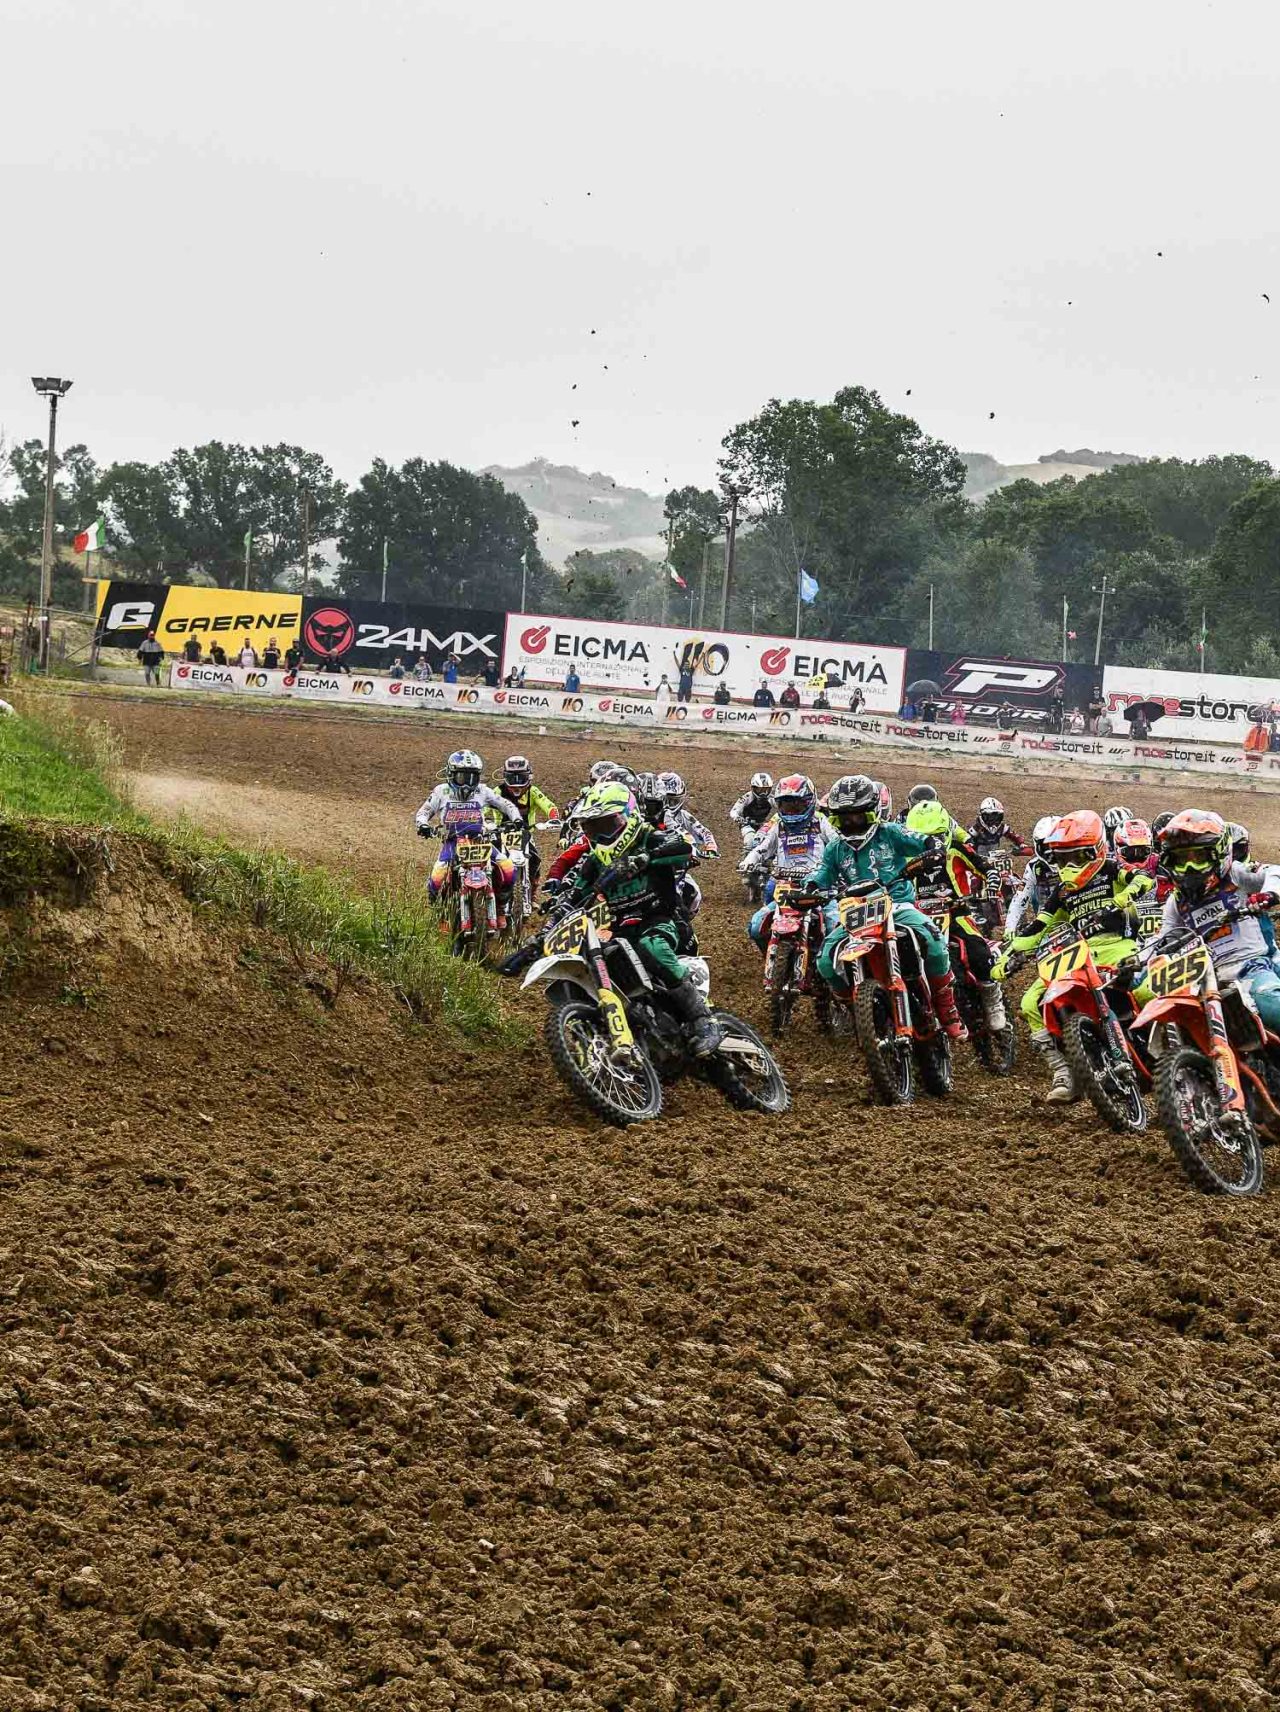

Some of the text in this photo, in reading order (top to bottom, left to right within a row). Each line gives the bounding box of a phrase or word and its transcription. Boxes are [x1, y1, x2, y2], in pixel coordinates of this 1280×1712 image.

[165, 612, 299, 634] GAERNE
[355, 624, 499, 658] 24MX
[554, 633, 650, 663] EICMA
[793, 654, 888, 685] EICMA
[190, 668, 233, 684] EICMA
[296, 677, 340, 692] EICMA
[403, 685, 445, 699] EICMA
[508, 694, 550, 708] EICMA
[612, 703, 654, 717] EICMA
[716, 711, 757, 723] EICMA
[459, 845, 491, 860] 927
[1195, 904, 1224, 925] ROYAL
[1046, 944, 1081, 981] 77
[1151, 950, 1206, 996] 425
